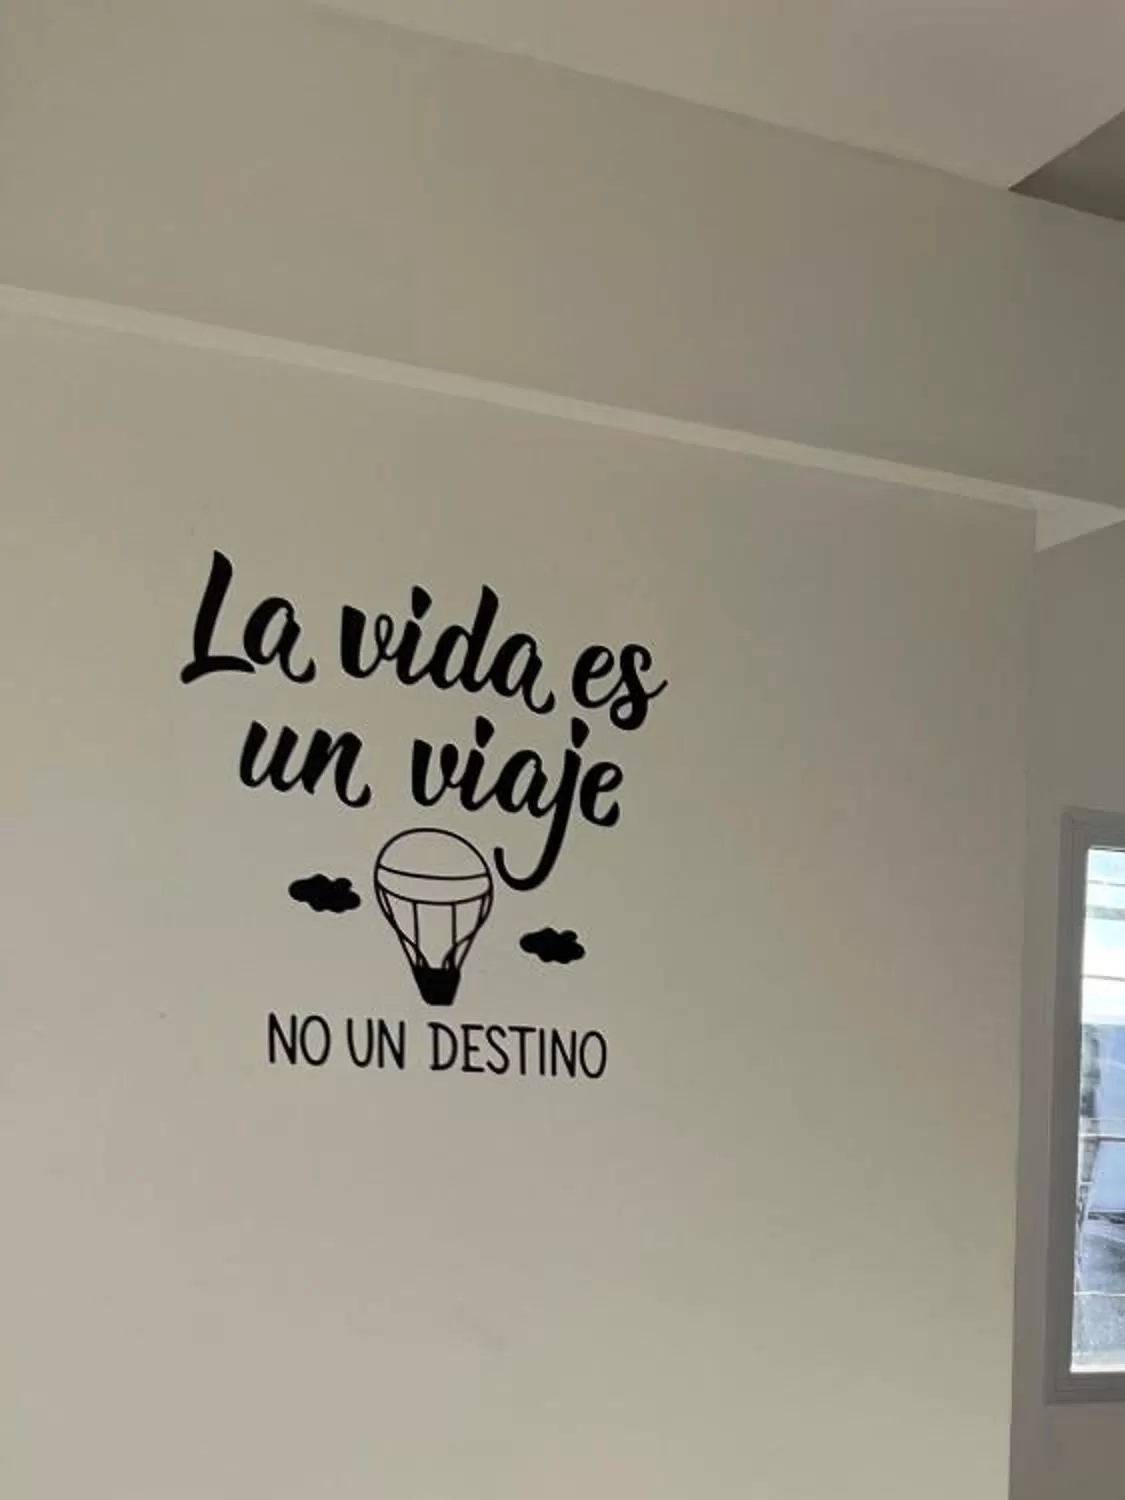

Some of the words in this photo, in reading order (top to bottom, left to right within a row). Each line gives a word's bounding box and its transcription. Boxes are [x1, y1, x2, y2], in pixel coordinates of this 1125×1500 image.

[180, 549, 317, 685] La
[339, 584, 556, 715] vida
[571, 643, 669, 731] es
[239, 720, 372, 809] un
[411, 715, 624, 892] viaje
[268, 1012, 331, 1067] NO
[346, 1017, 406, 1070] UN
[427, 1021, 607, 1079] DESTINO
